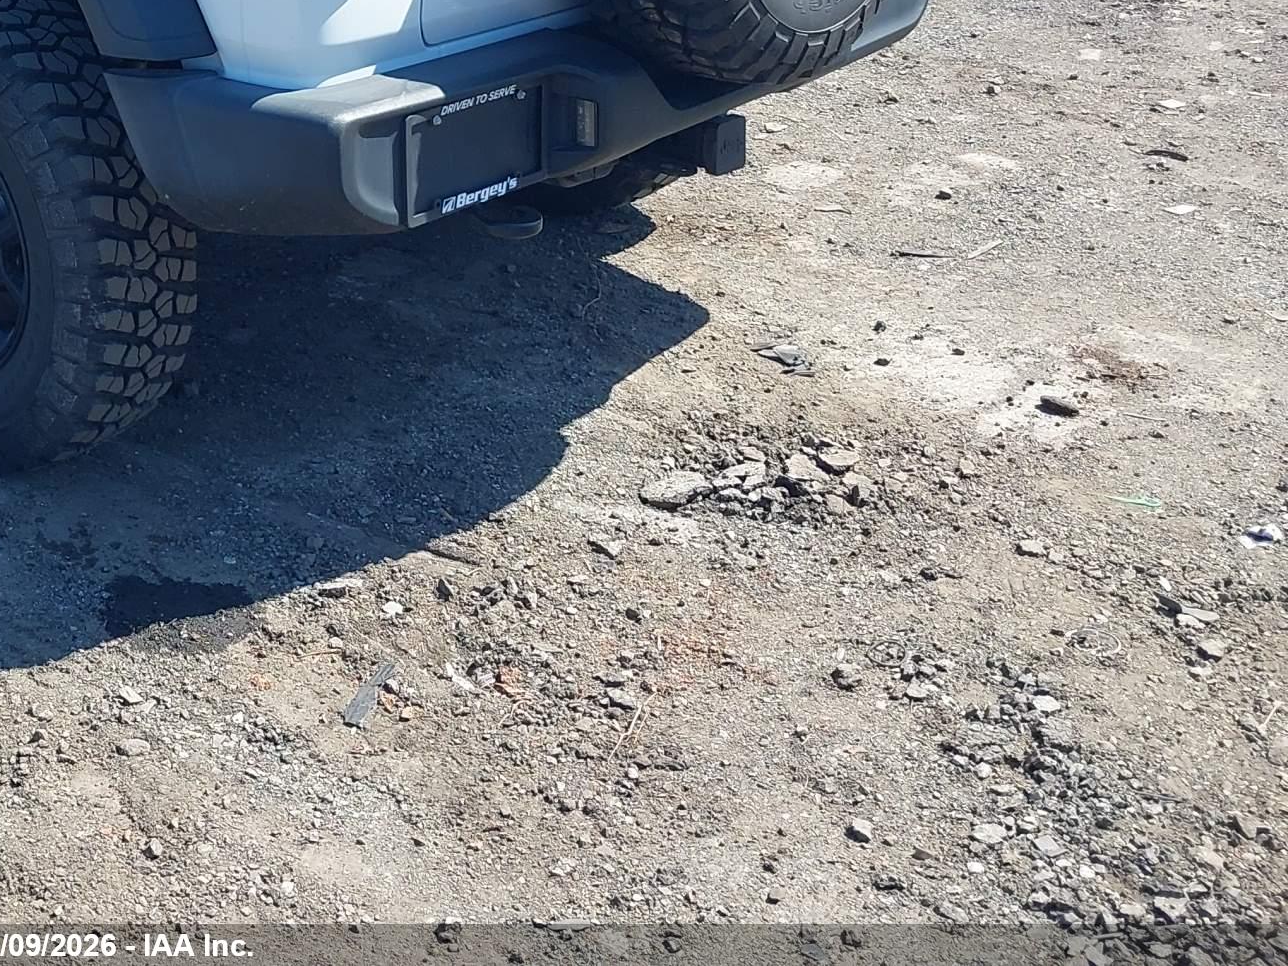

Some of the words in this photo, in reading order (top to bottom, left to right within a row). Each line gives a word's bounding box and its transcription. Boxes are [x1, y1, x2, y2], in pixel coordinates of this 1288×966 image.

[440, 99, 475, 117] DRIVEN
[475, 94, 488, 107] TO
[487, 84, 517, 103] SERVE
[455, 176, 518, 209] Bergey's
